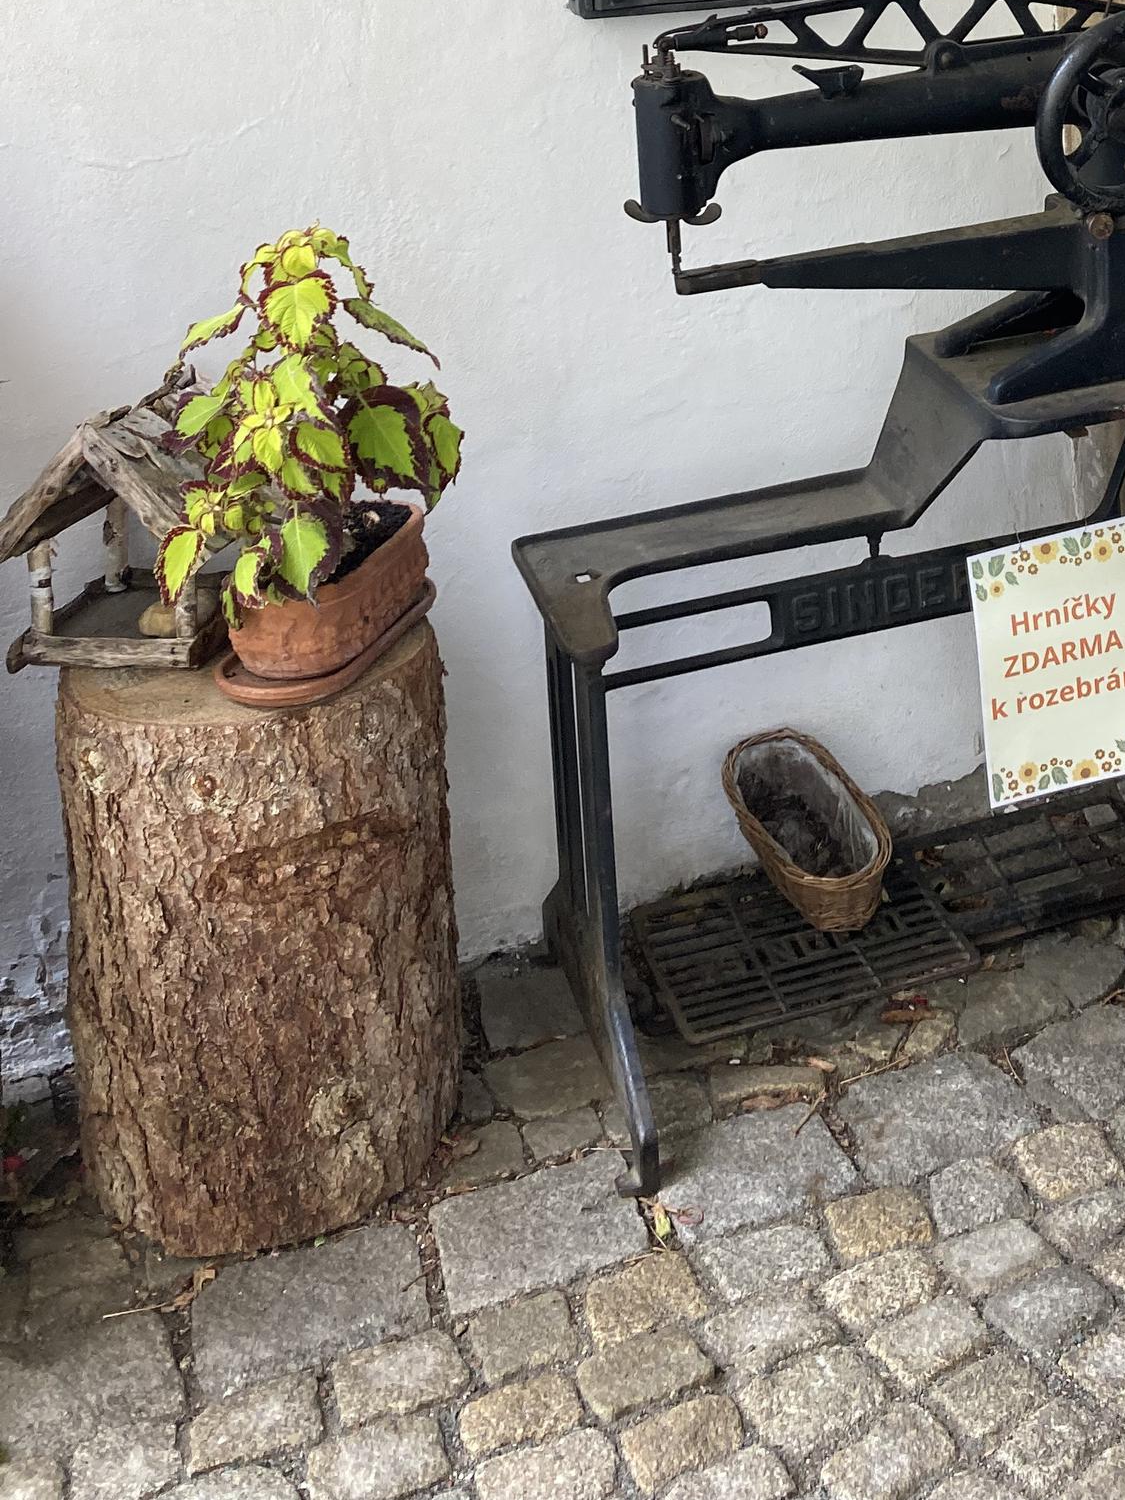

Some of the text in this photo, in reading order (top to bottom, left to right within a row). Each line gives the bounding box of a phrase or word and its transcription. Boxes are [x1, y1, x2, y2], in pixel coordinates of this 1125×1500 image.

[1010, 592, 1116, 637] Hrníčky
[1003, 629, 1124, 678] ZDARMA
[991, 698, 1009, 721] k
